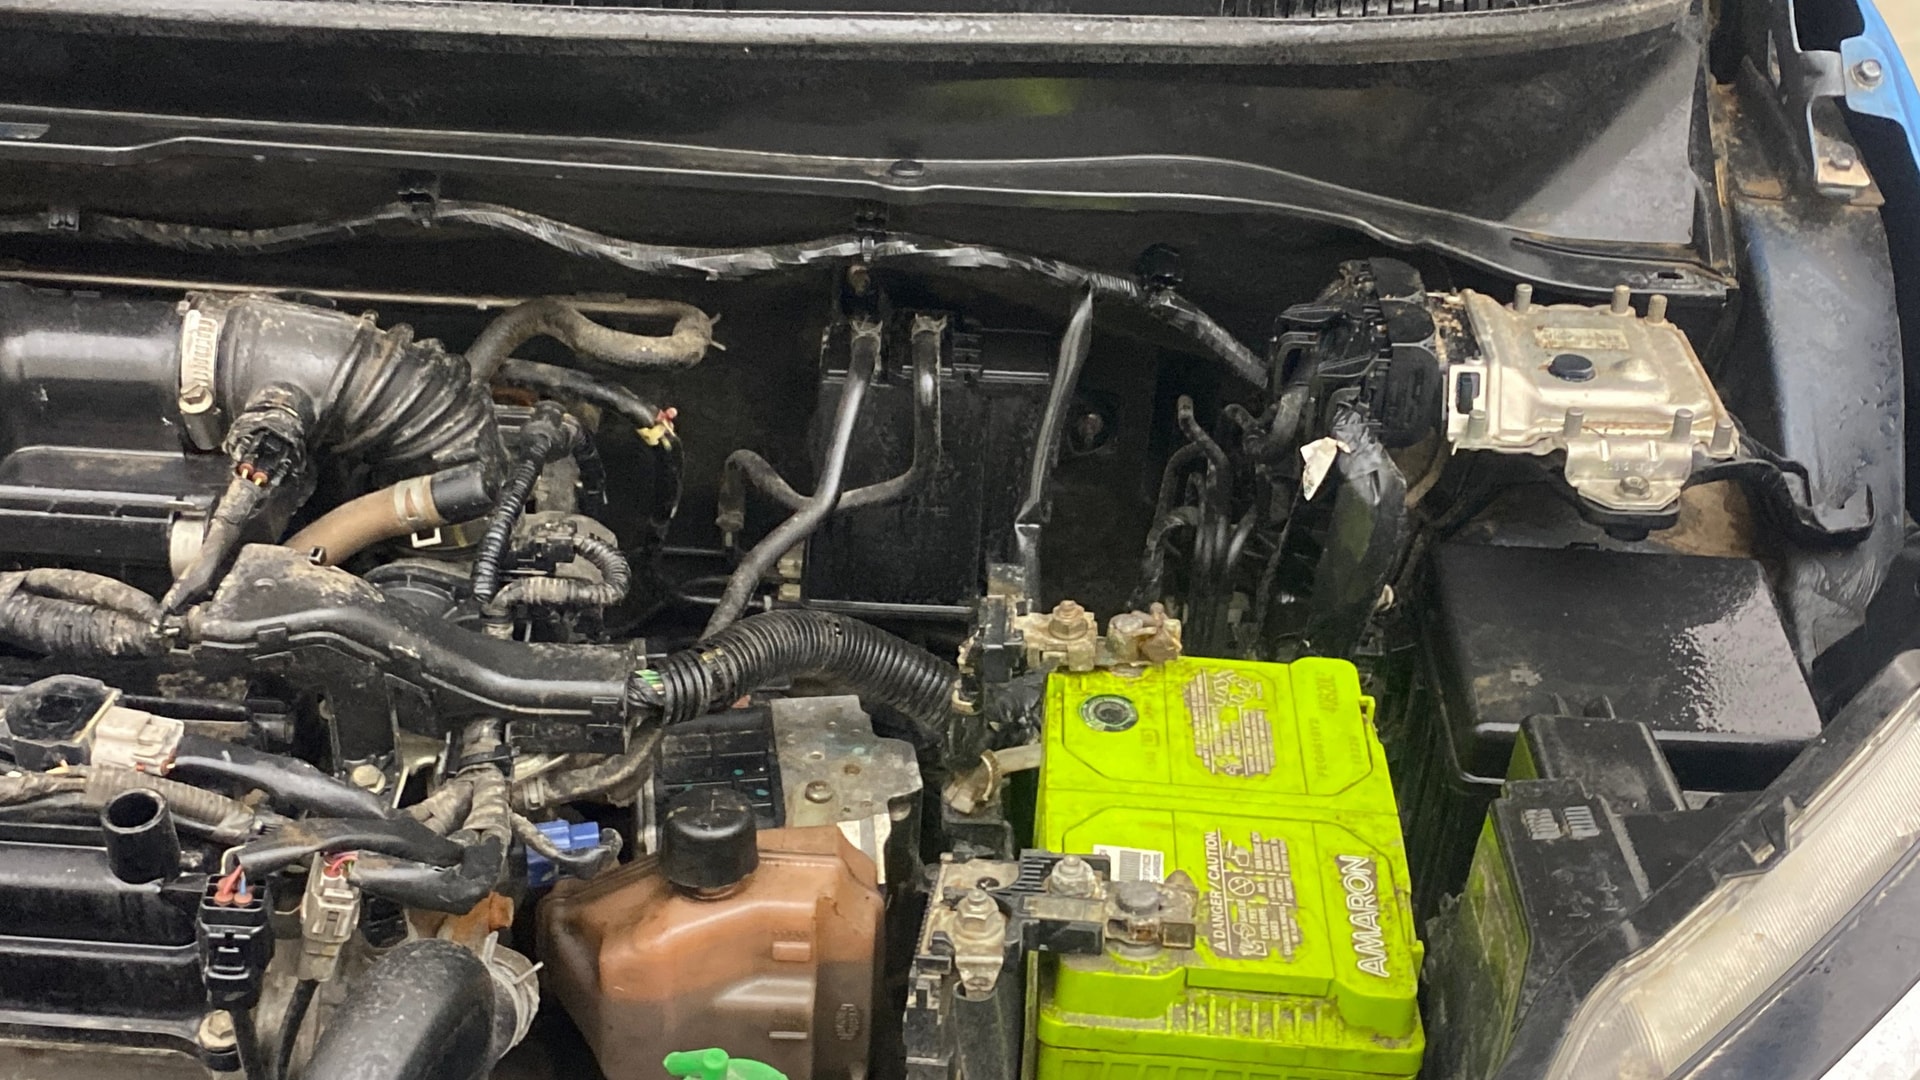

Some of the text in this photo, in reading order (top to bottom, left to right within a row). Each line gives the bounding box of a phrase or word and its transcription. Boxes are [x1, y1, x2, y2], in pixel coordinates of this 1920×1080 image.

[1205, 832, 1220, 880] CAUTION
[1211, 890, 1226, 939] DANGER
[1339, 855, 1390, 978] AMARON
